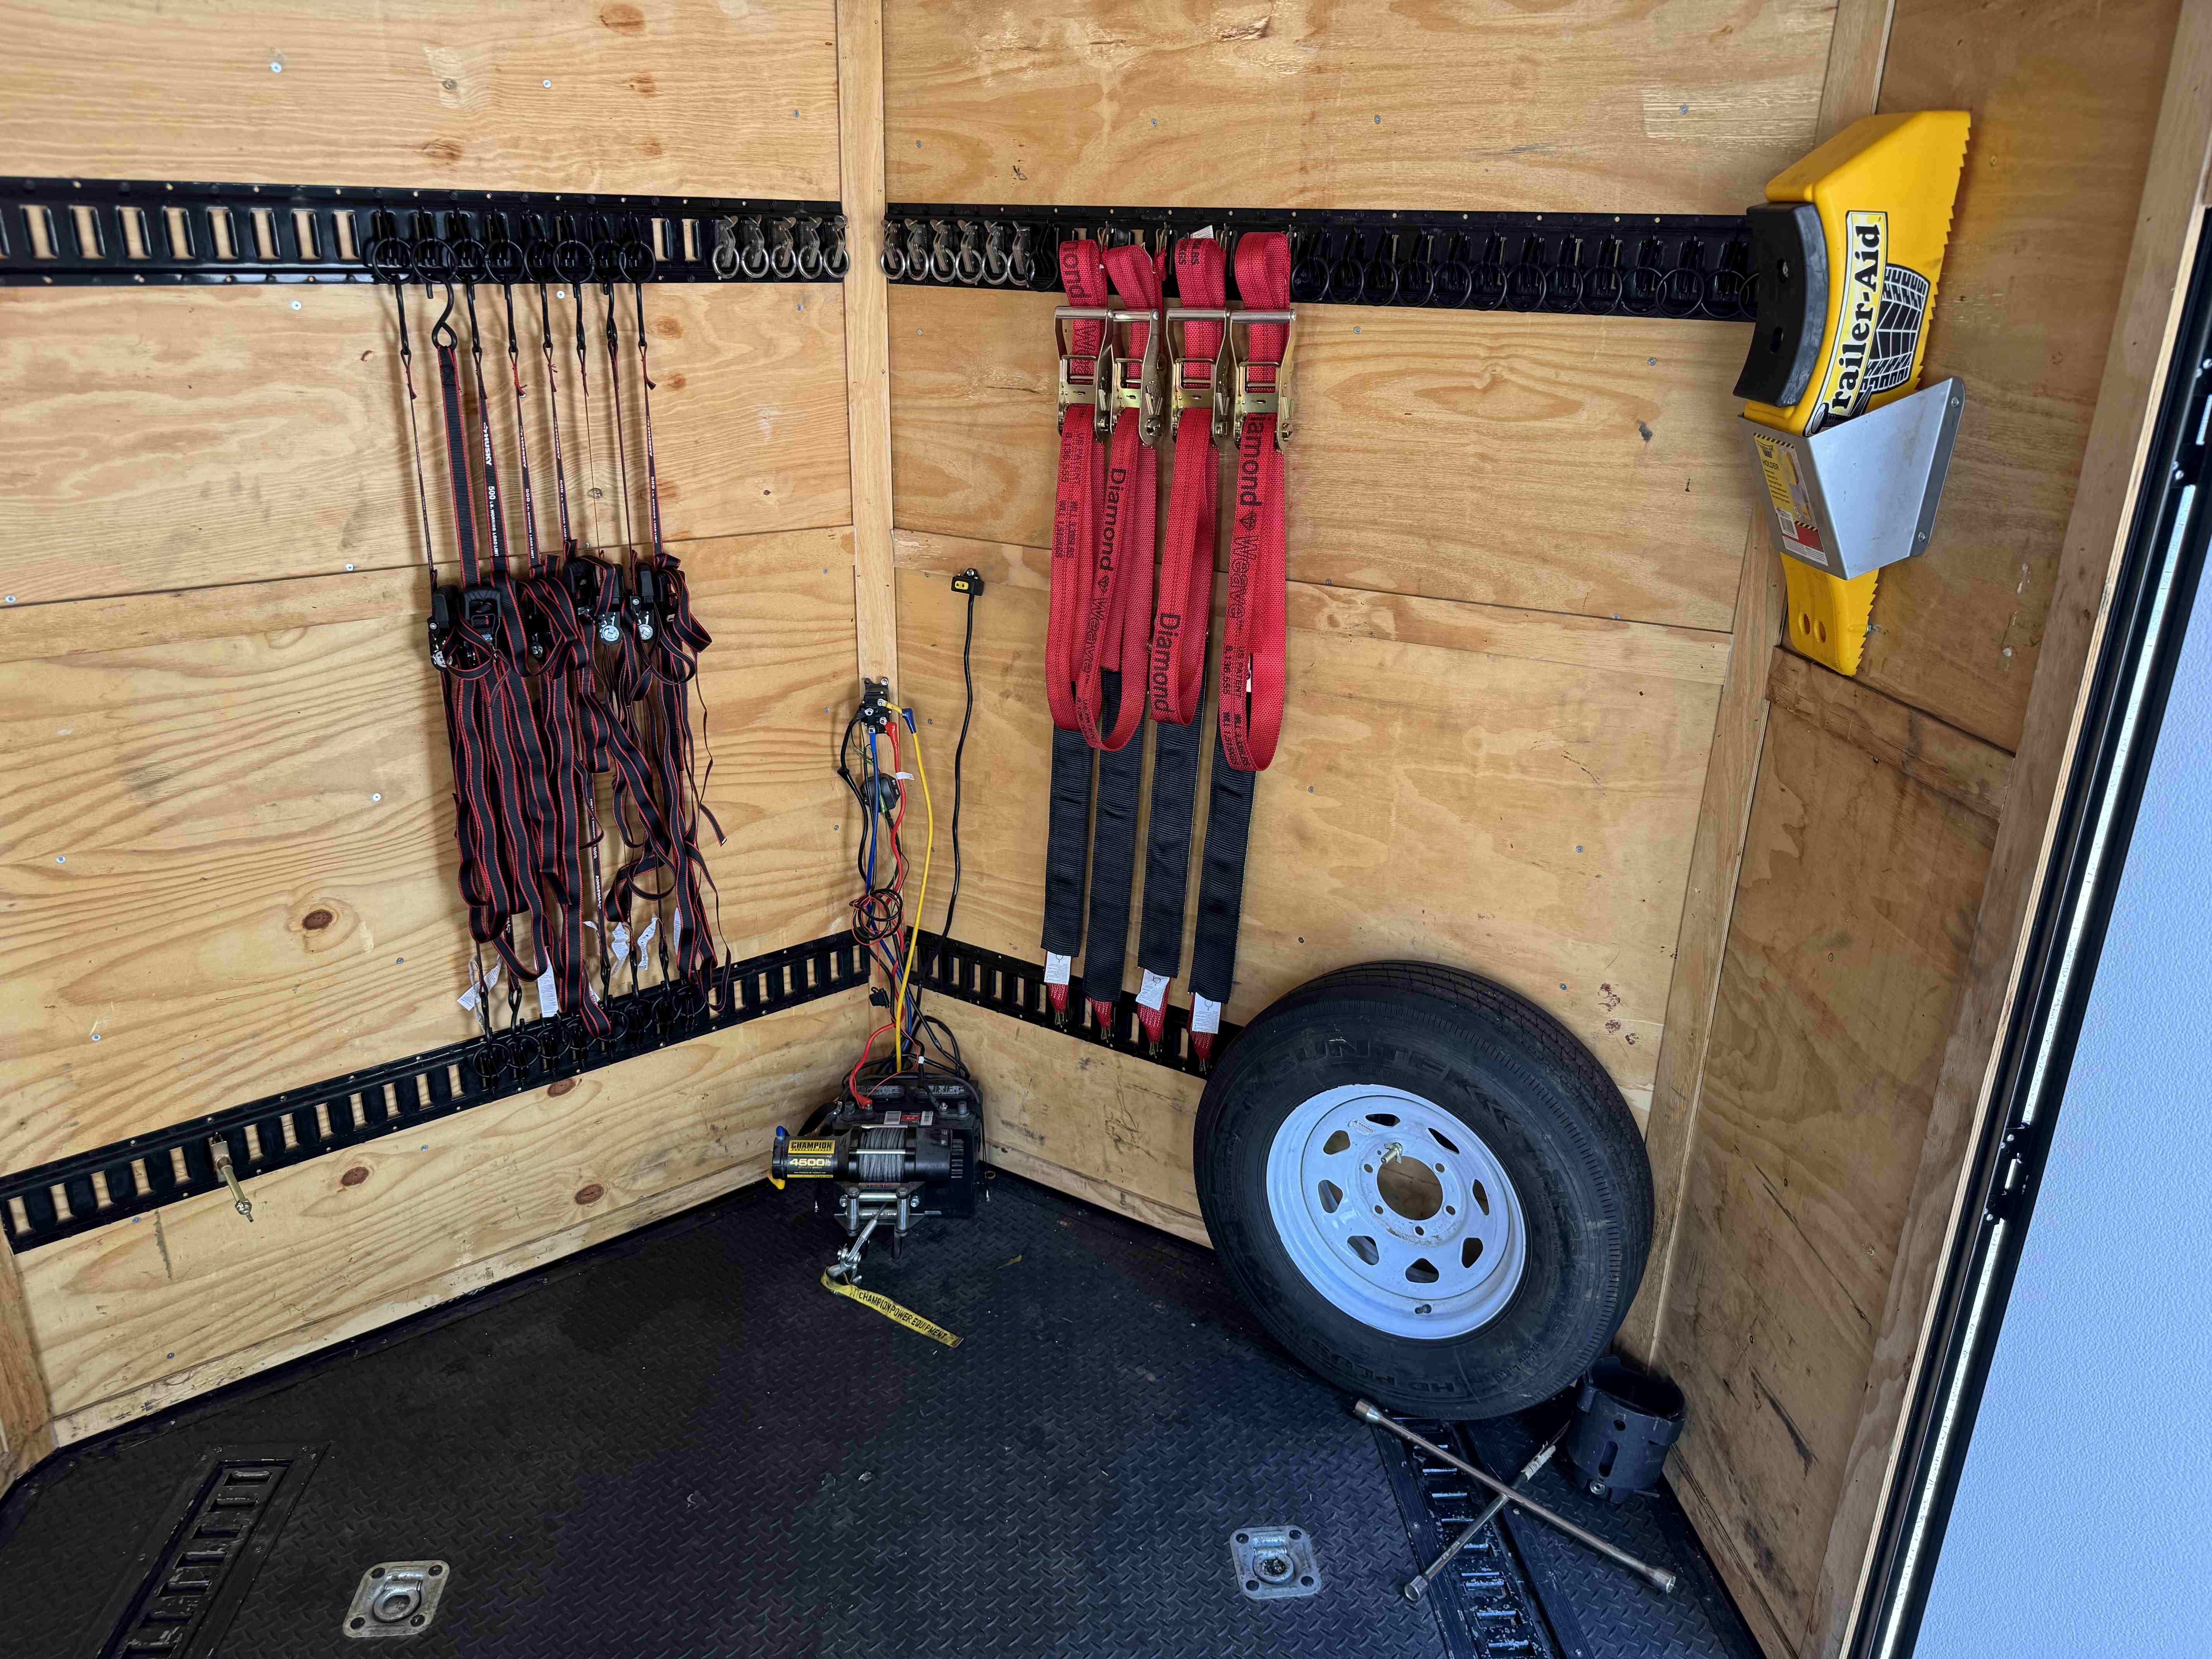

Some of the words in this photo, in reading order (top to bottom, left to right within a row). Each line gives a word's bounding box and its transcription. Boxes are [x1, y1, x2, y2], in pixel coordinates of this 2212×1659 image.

[484, 434, 492, 465] HUSKY
[1240, 414, 1272, 506] iamond
[1099, 468, 1126, 572] Diamond
[1234, 661, 1243, 699] PATENT
[859, 1291, 892, 1312] CHAMPION
[889, 1305, 913, 1324] POWER
[911, 1318, 948, 1339] EQUIPMENT
